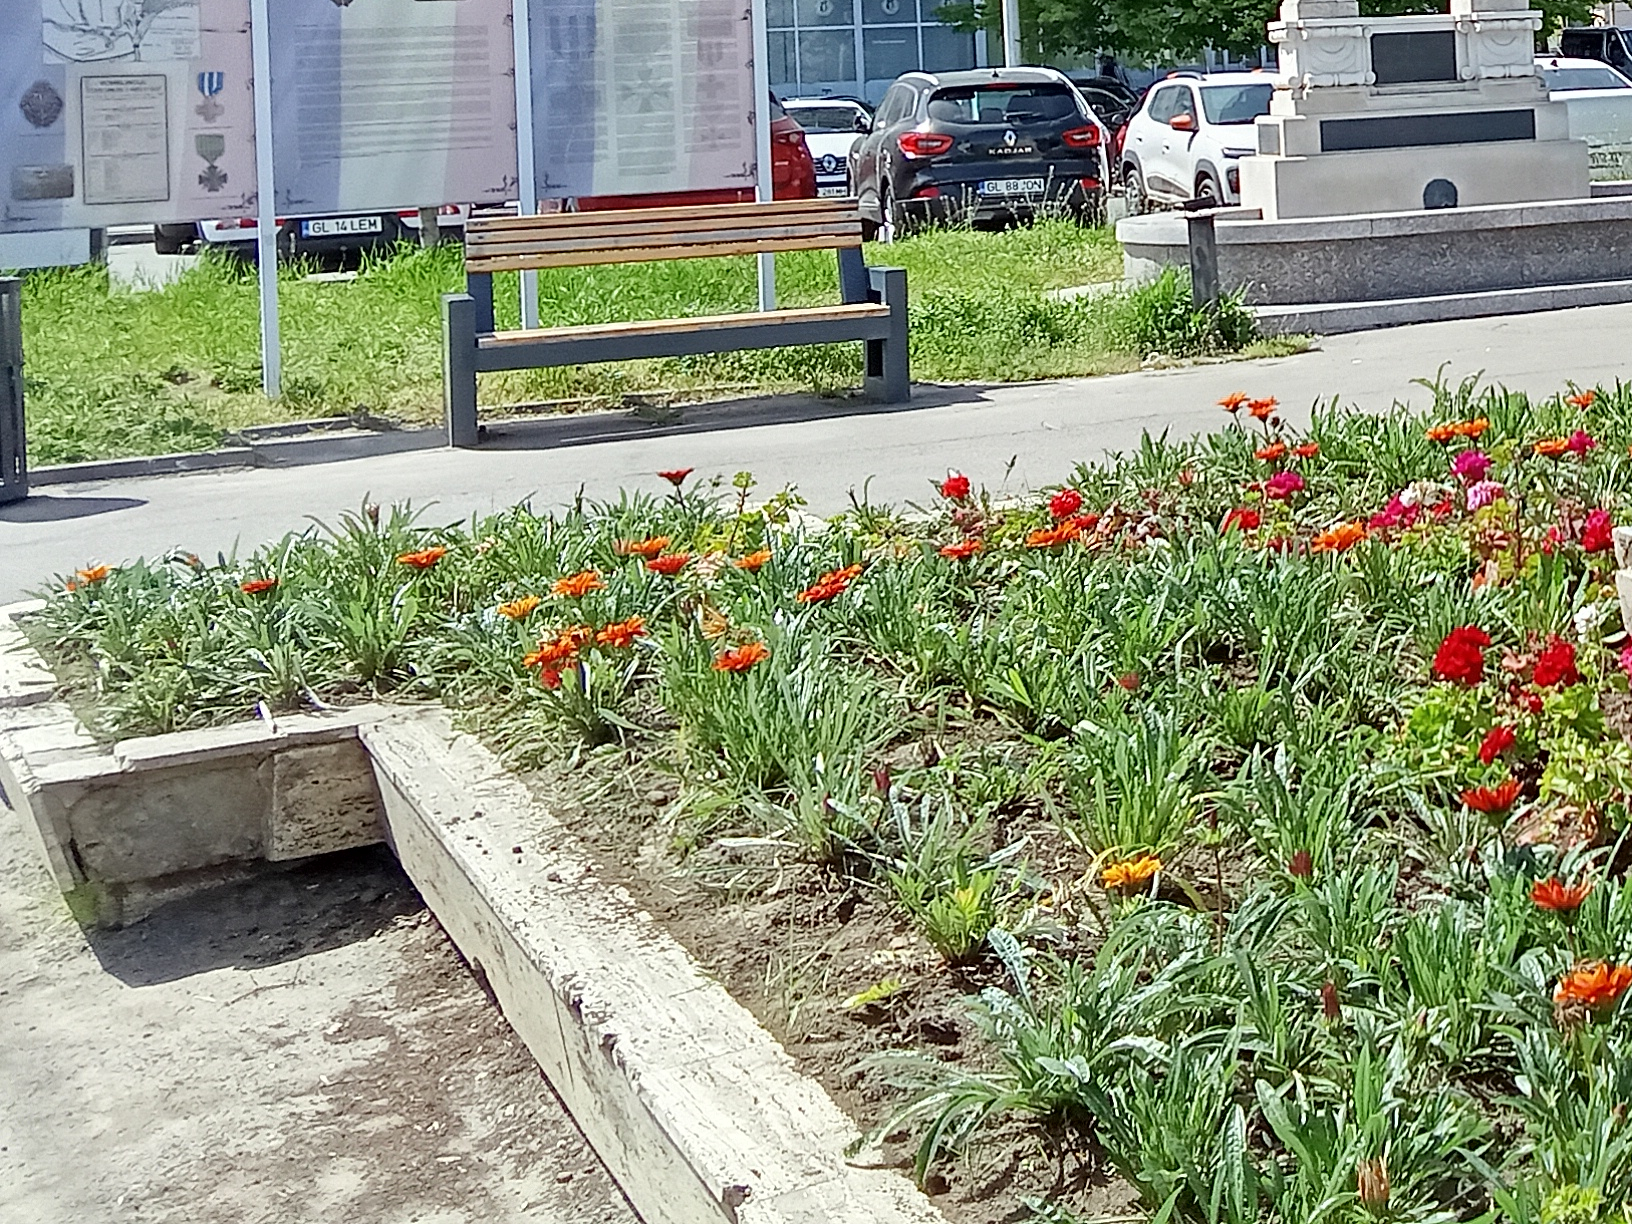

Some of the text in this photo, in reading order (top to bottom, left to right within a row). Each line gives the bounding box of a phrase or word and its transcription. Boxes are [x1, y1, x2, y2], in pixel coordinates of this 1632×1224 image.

[988, 147, 1032, 155] KADJAR
[986, 182, 1001, 192] GL
[1005, 181, 1019, 191] 88
[312, 218, 378, 233] GL 14 LEM
